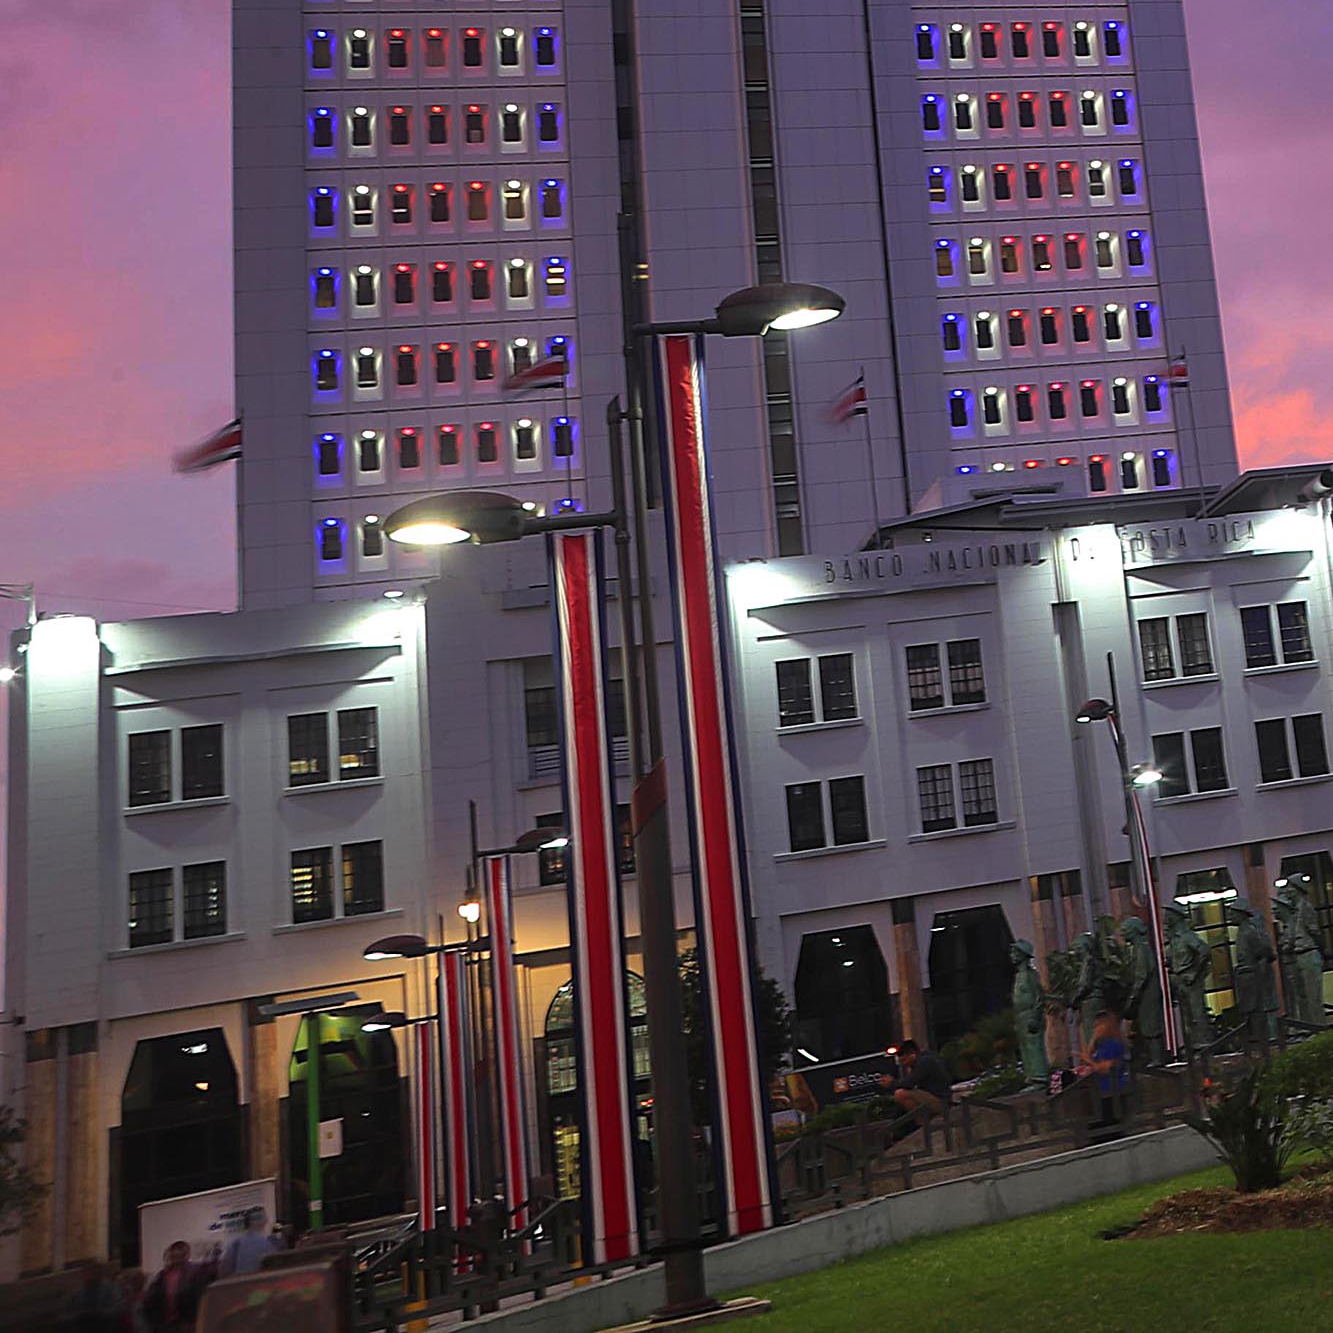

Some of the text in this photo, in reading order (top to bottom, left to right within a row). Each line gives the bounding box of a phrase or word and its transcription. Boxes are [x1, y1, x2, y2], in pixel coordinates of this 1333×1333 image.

[824, 554, 903, 584] BANCO
[1070, 537, 1097, 562] D
[1207, 520, 1256, 545] RICA
